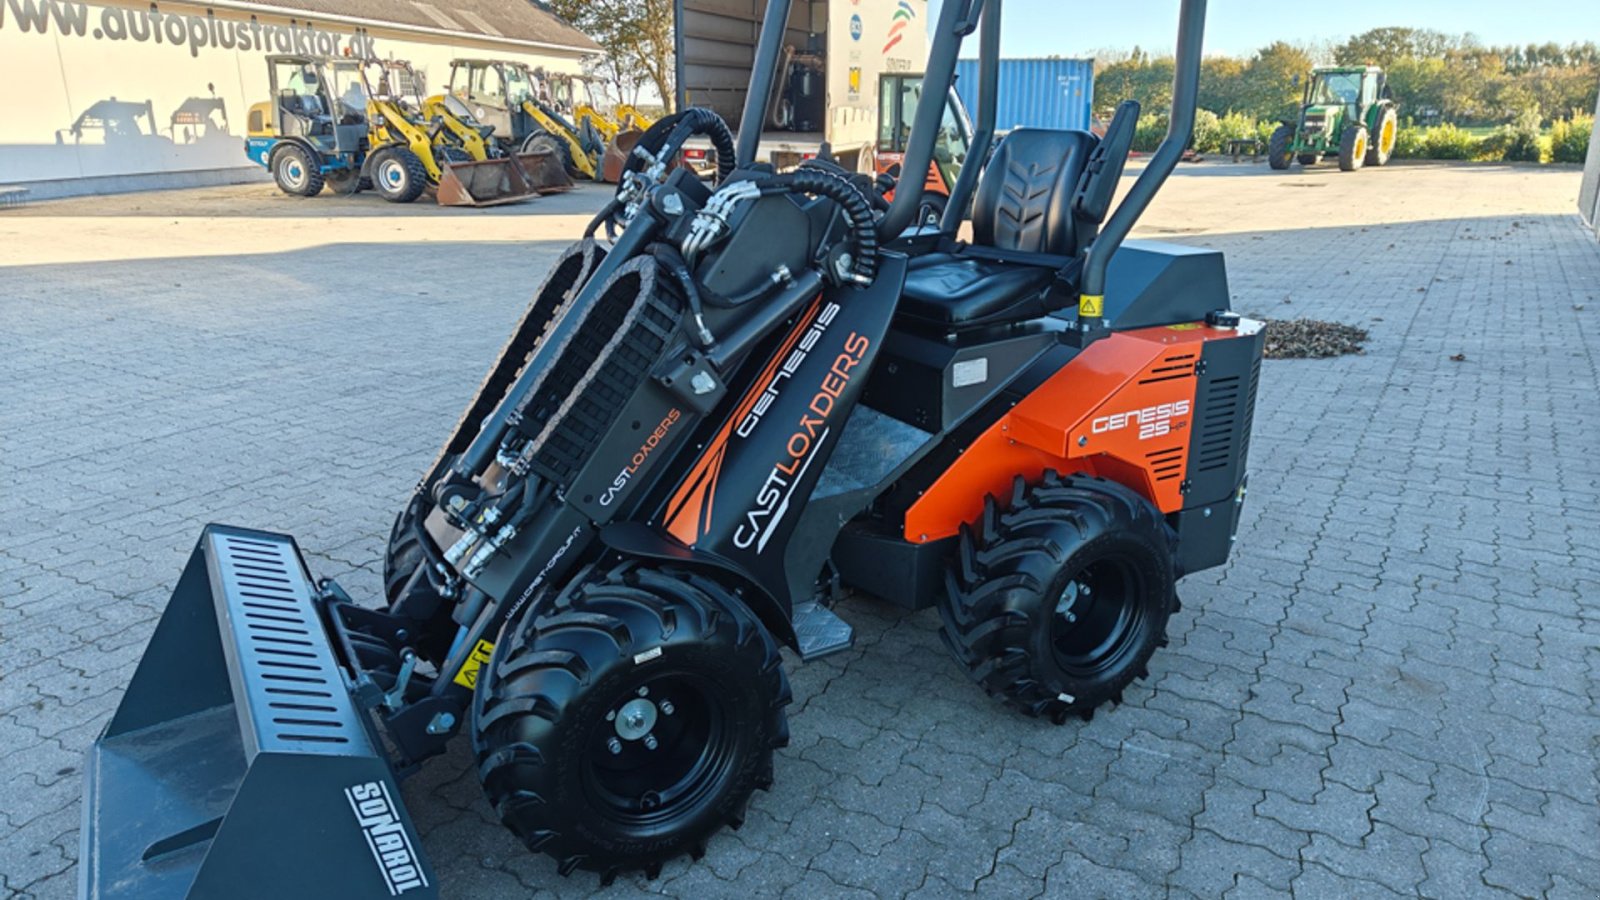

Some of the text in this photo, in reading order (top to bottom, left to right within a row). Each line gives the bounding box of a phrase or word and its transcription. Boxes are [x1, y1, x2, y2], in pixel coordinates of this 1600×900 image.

[0, 0, 375, 59] ww.autoplustraktordk
[736, 301, 840, 438] GENESIS
[1092, 399, 1191, 434] GENESIS
[599, 408, 682, 506] CASTLOADERS
[733, 331, 871, 550] CASTLOADERS
[1138, 419, 1171, 440] 25
[348, 781, 425, 896] SONAROL
